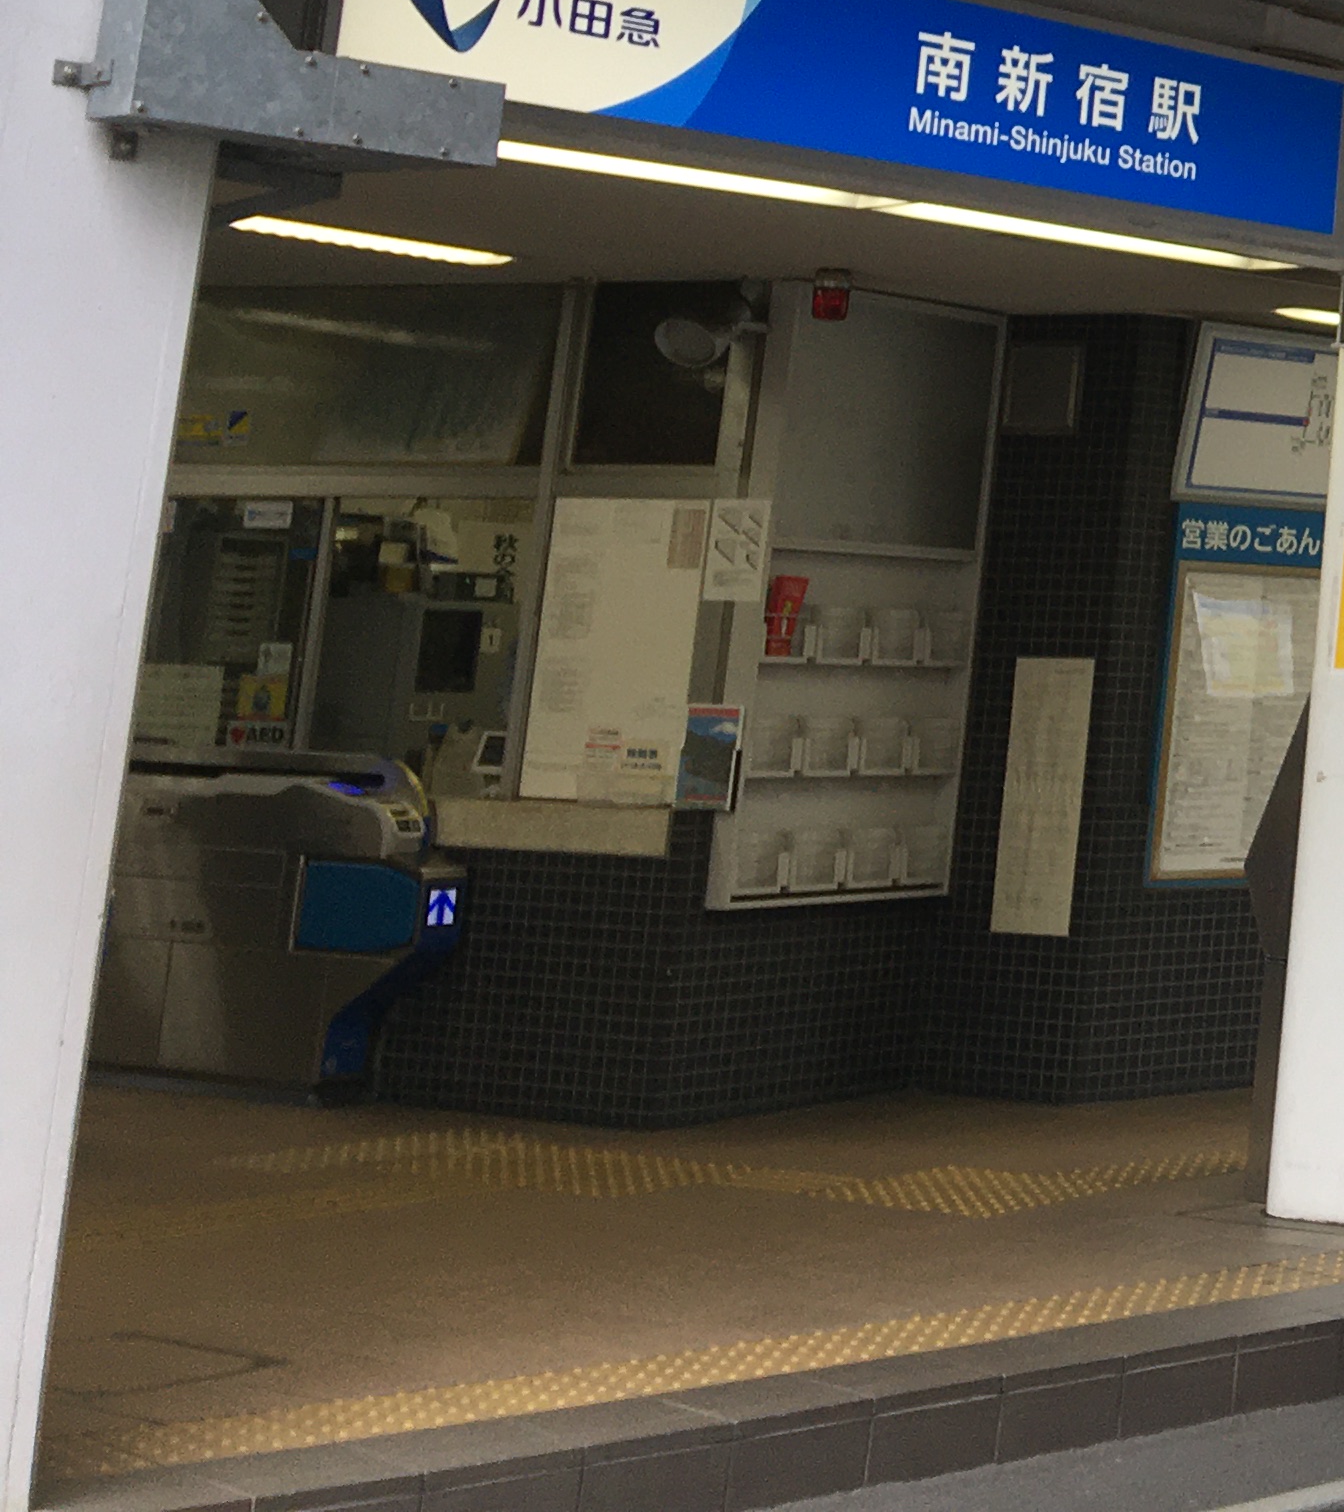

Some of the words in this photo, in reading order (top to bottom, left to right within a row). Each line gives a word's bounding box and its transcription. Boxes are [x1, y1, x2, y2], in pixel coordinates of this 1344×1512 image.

[914, 31, 1202, 145] 南新宿駅
[908, 106, 1111, 164] Minami-Shinjuku
[1117, 144, 1198, 181] Station
[1182, 519, 1321, 557] 営業のごあん
[245, 725, 284, 744] AED
